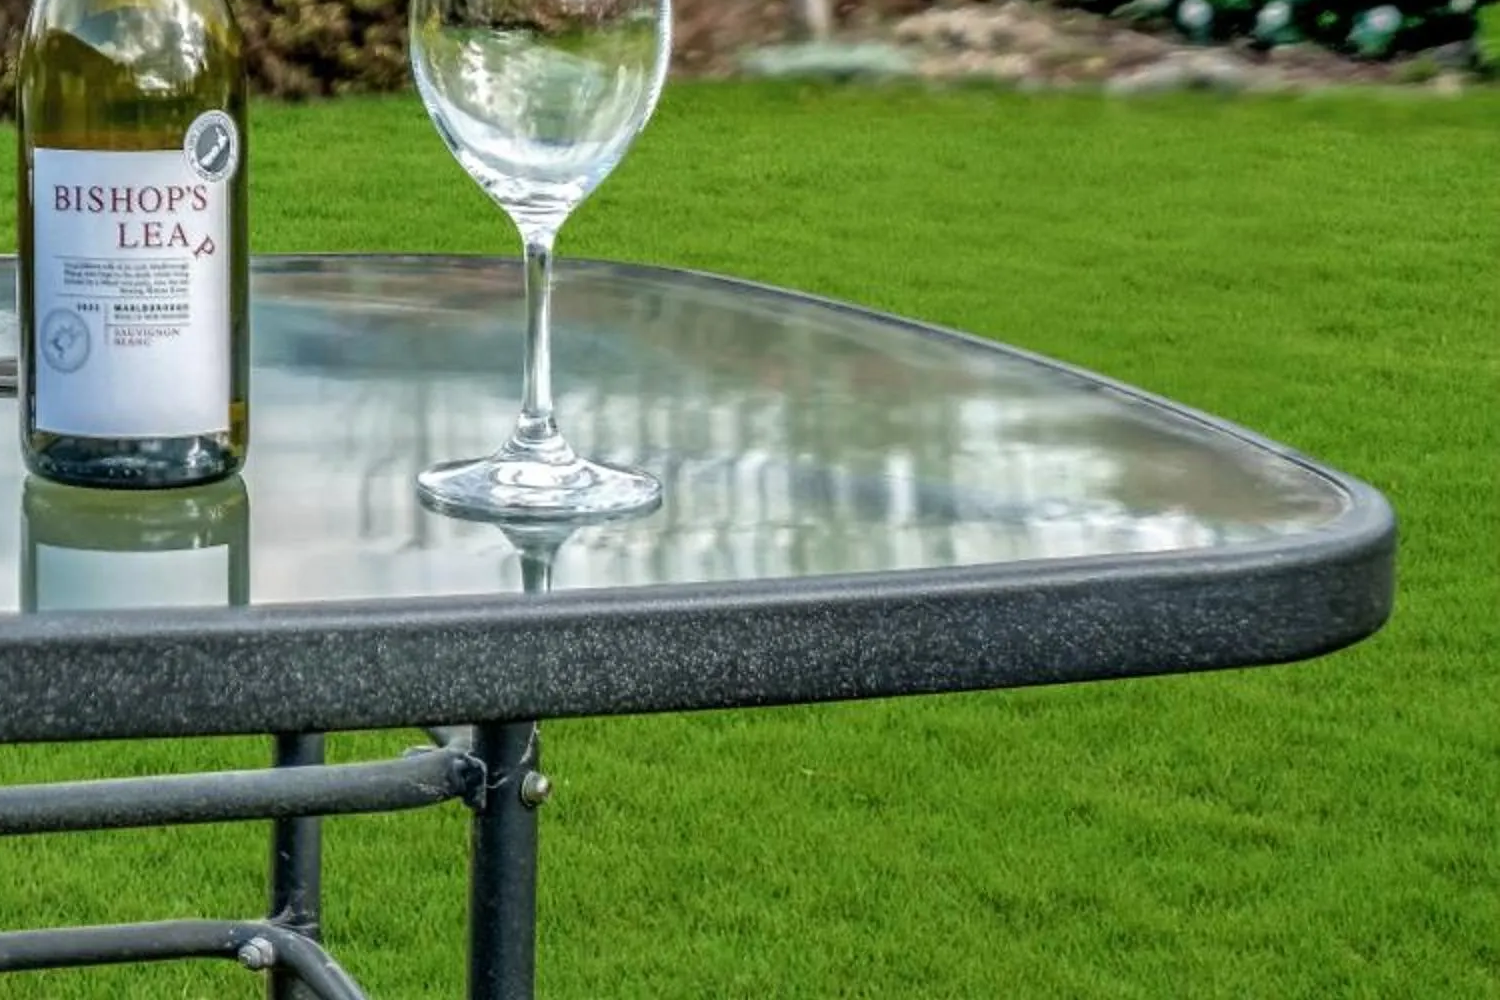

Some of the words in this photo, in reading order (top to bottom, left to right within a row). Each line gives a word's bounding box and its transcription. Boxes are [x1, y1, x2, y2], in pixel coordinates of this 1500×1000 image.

[54, 184, 208, 213] BISHOP'S
[117, 222, 216, 259] LEAP
[114, 328, 180, 338] SAUVIGNON
